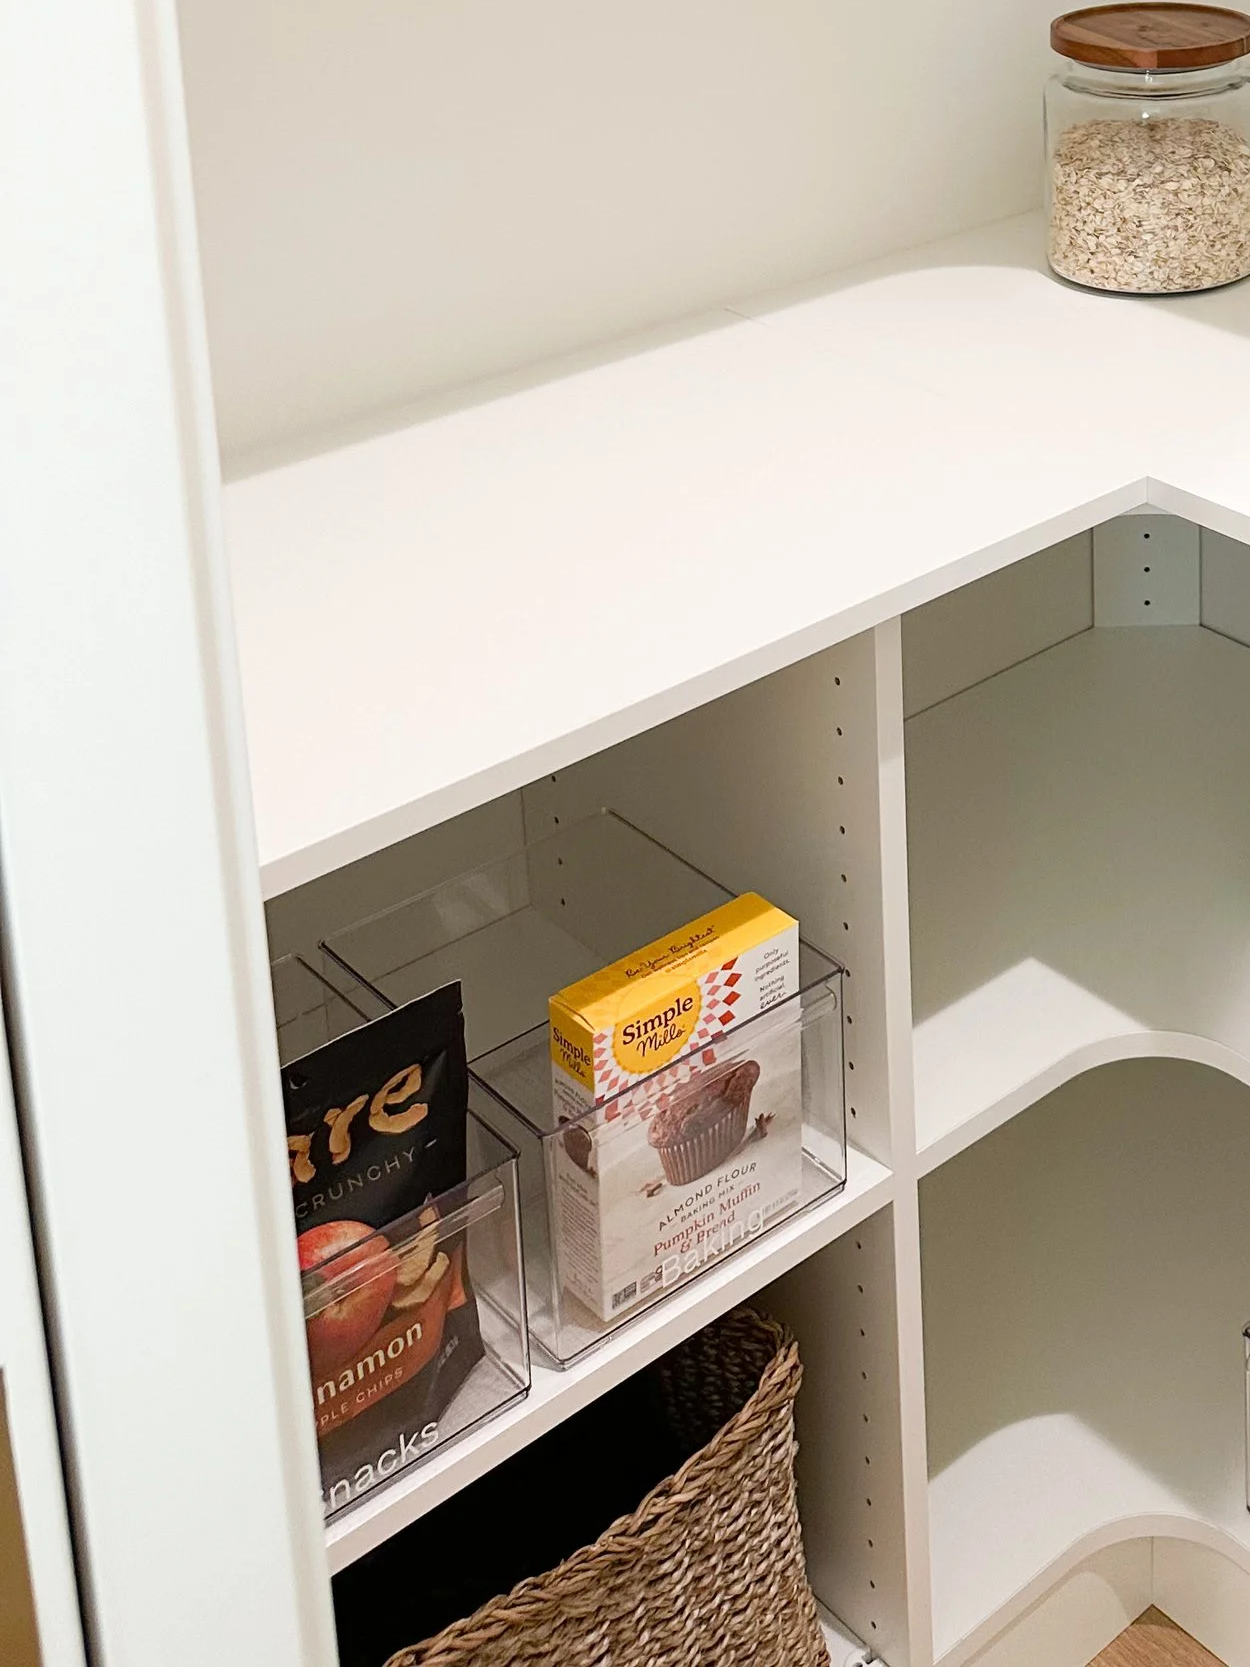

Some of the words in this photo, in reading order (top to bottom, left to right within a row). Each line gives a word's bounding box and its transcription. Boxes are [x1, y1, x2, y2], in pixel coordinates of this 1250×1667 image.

[754, 950, 789, 975] purposeful
[763, 946, 780, 960] Only
[759, 974, 785, 993] Nothing
[622, 996, 694, 1046] Simple
[636, 1024, 686, 1058] Mills
[552, 1026, 591, 1066] Simple
[295, 1146, 416, 1219] CRUNCHY
[659, 1183, 713, 1231] ALMOND
[716, 1161, 758, 1187] FLOUR
[680, 1197, 716, 1223] BAKING
[718, 1184, 736, 1199] MIX
[653, 1211, 716, 1257] Pumpkin
[718, 1181, 761, 1215] Muffin
[660, 1205, 765, 1289] Baking
[680, 1238, 692, 1254] &
[315, 1403, 350, 1427] PLE
[356, 1366, 404, 1404] CHIPS
[322, 1420, 440, 1509] nacks
